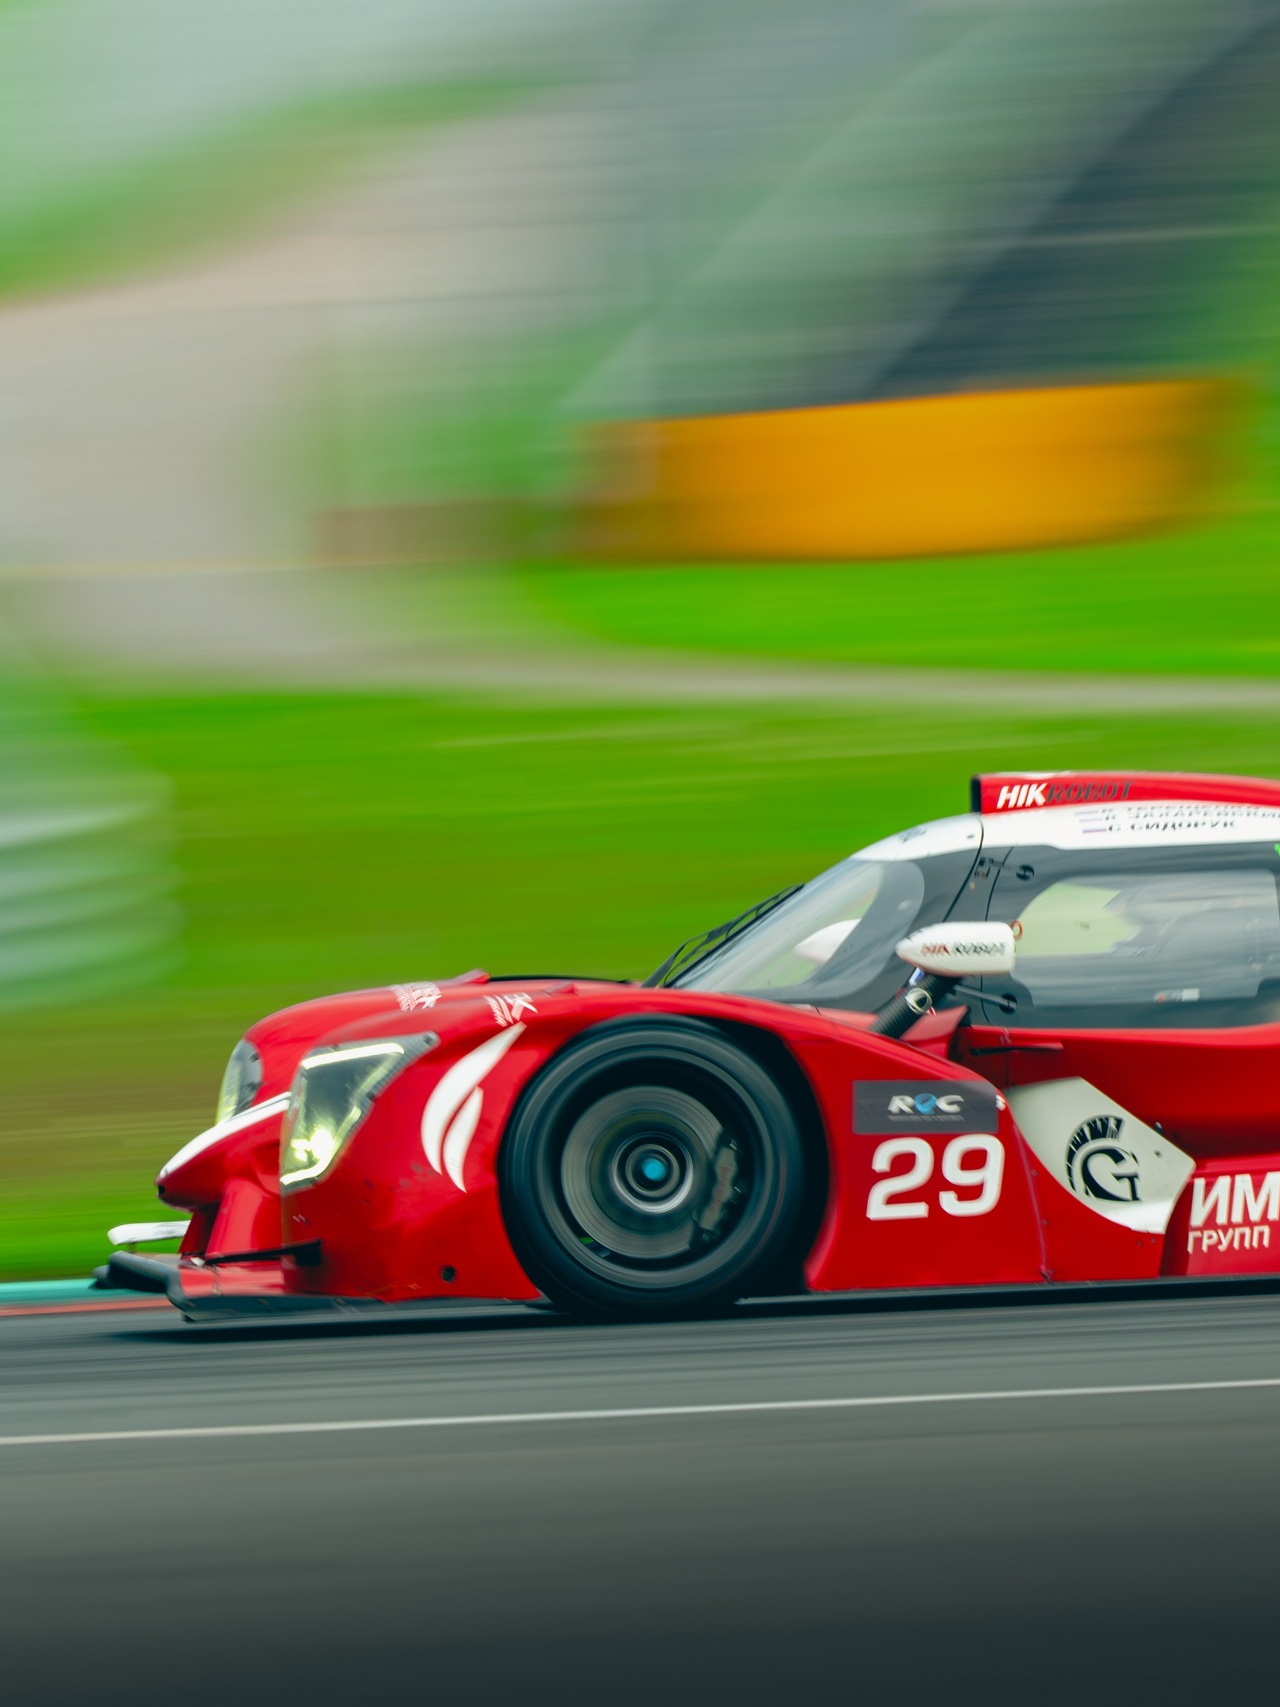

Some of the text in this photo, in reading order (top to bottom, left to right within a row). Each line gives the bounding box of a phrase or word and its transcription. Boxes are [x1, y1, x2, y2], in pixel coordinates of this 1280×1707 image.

[997, 779, 1138, 809] HIKROBOT
[866, 1133, 1006, 1222] 29
[1187, 1225, 1270, 1254] ГРУПП
